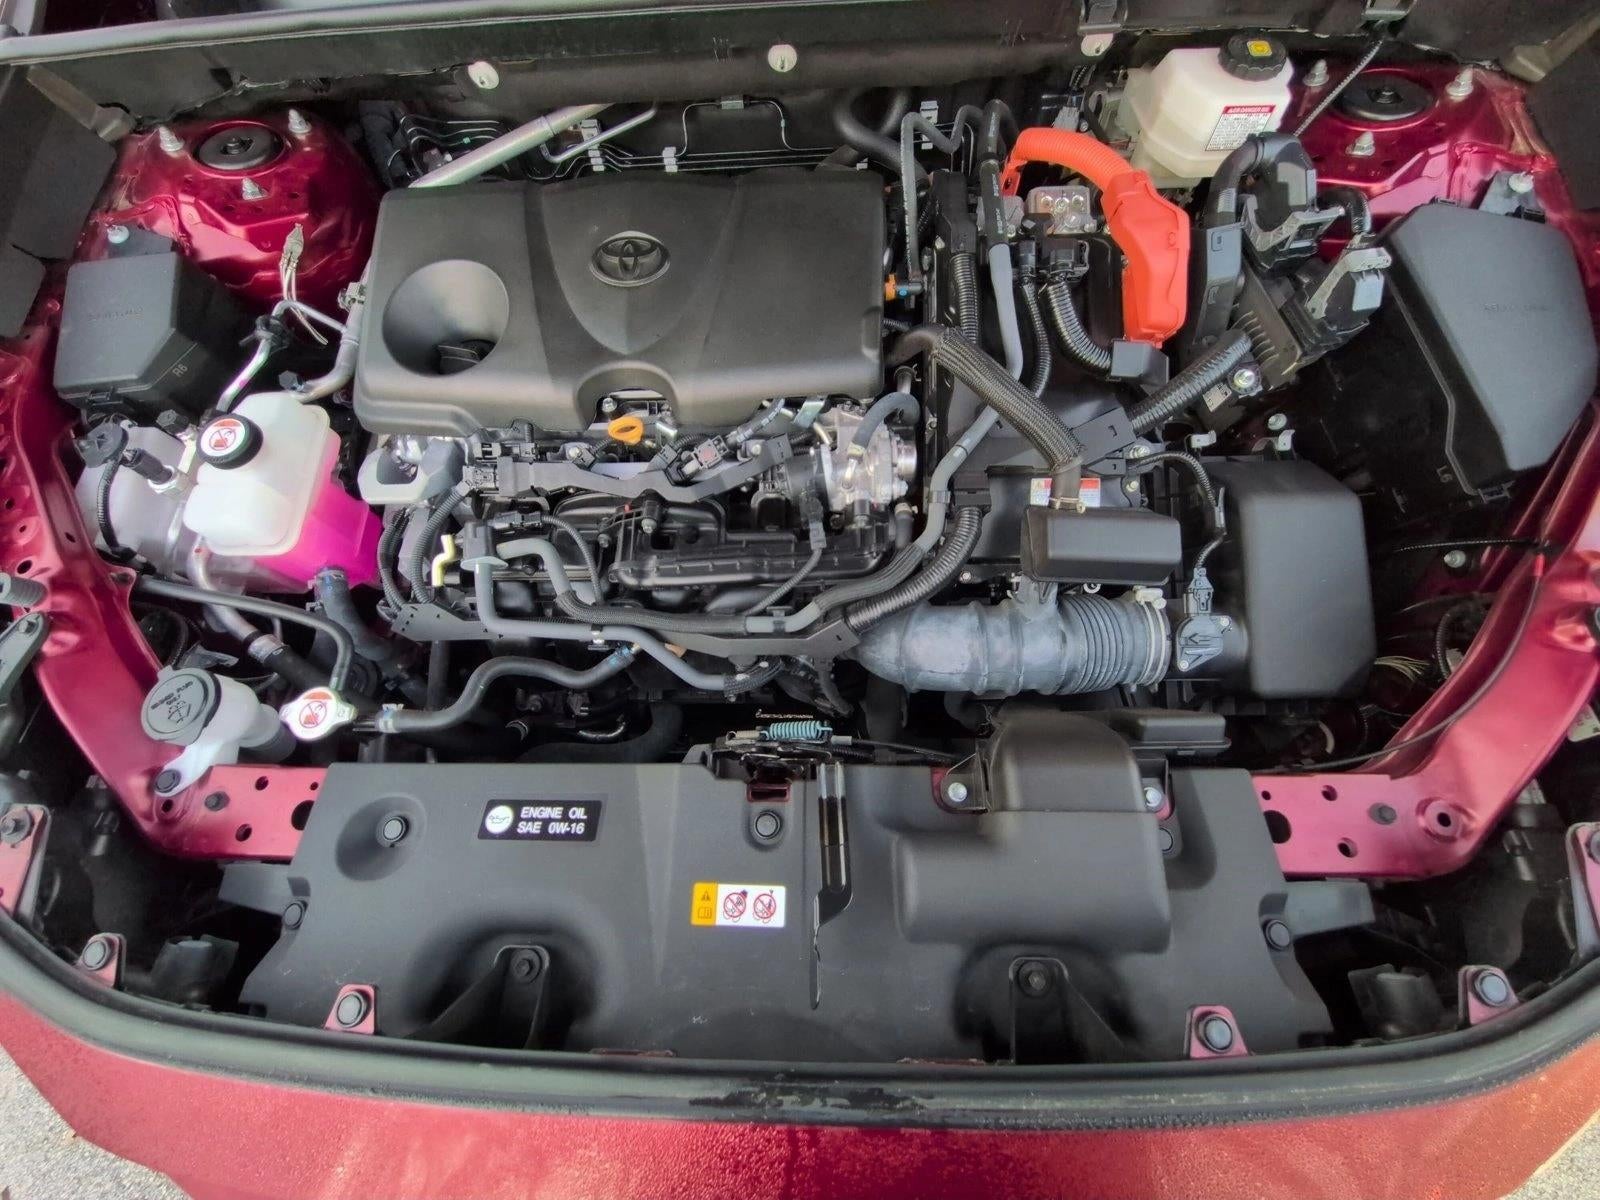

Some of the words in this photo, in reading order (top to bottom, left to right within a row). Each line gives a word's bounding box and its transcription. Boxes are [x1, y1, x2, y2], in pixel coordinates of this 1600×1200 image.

[520, 806, 564, 819] ENGINE
[568, 807, 588, 819] OIL
[516, 821, 543, 834] SAE
[547, 822, 585, 834] 0W-16
